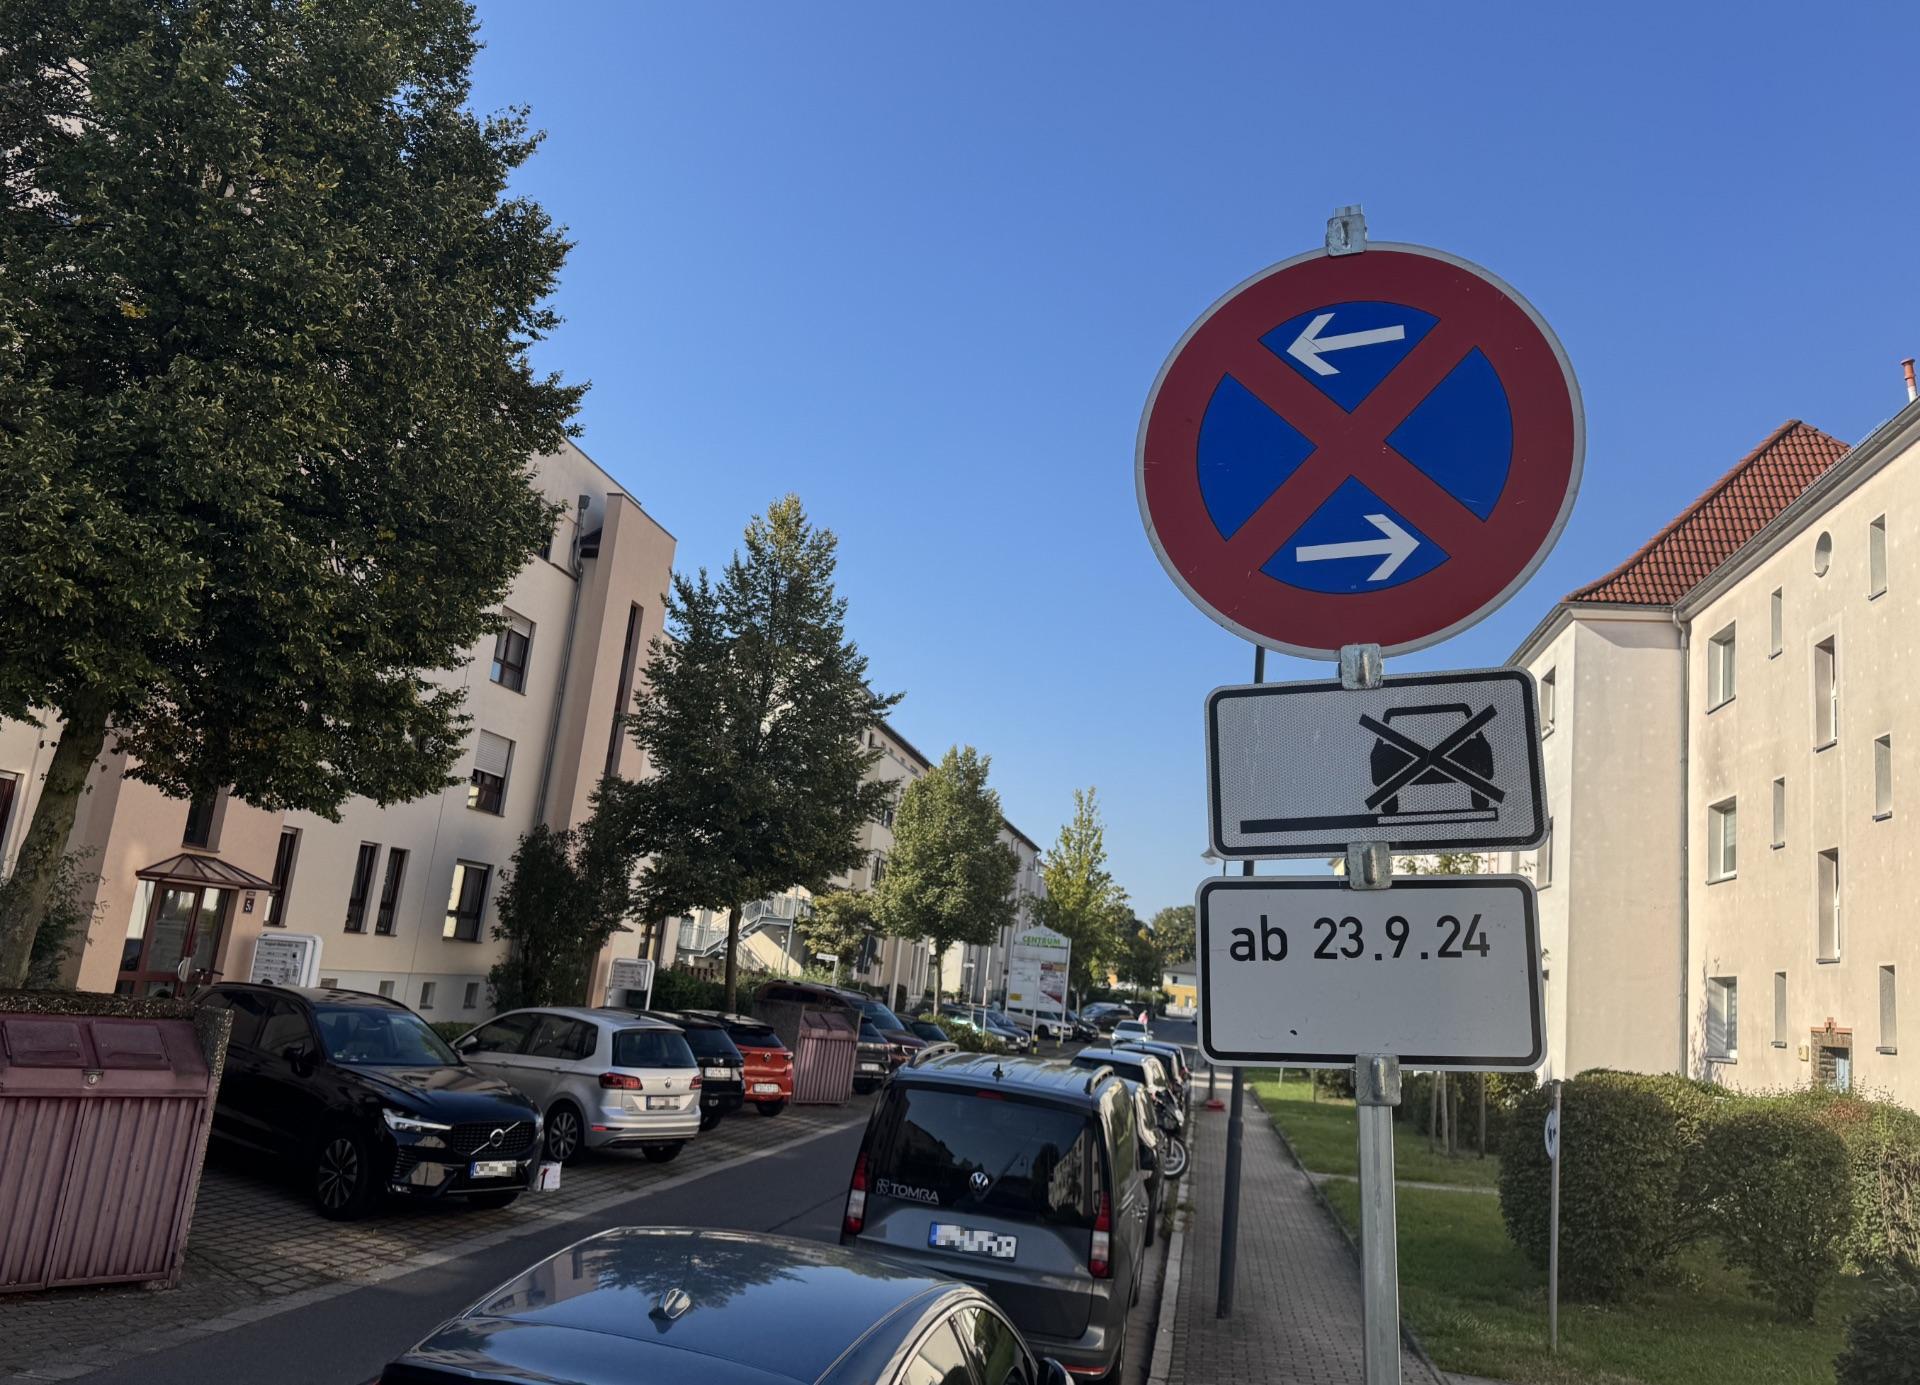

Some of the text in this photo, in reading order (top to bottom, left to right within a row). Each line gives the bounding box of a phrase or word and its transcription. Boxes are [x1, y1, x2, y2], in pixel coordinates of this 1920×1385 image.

[1023, 935, 1061, 946] CENTRUM
[1229, 914, 1288, 962] ab
[890, 1183, 939, 1202] TOMRA
